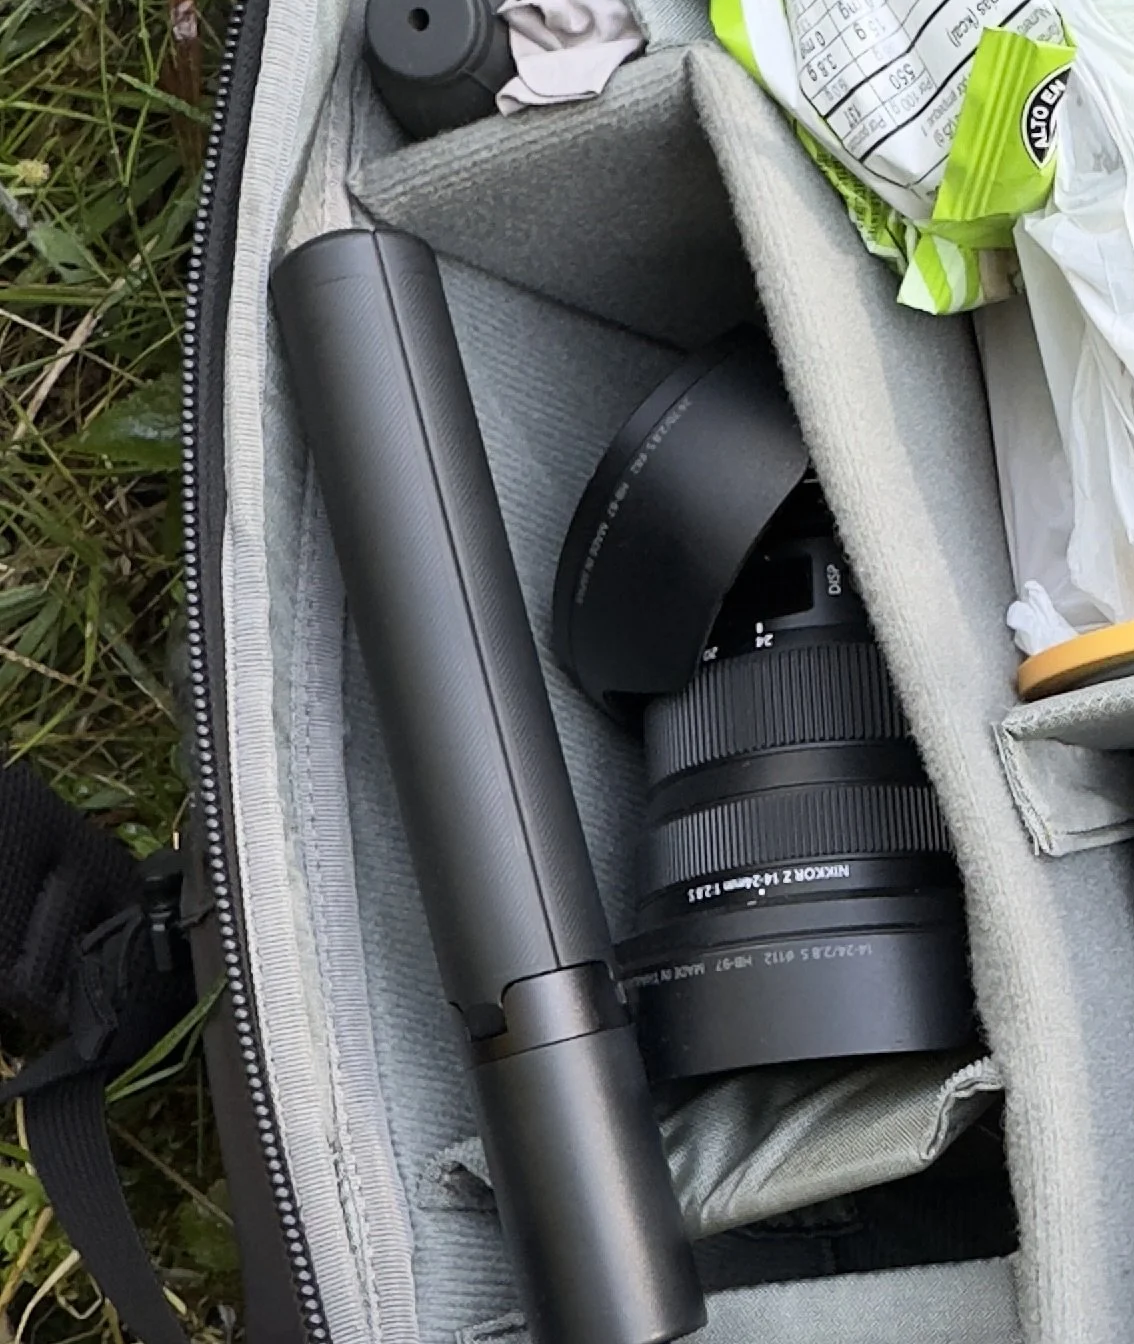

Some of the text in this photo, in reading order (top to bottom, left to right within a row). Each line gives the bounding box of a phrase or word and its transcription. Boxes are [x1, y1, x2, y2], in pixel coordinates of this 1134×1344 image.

[853, 20, 867, 41] g
[946, 7, 980, 48] (kcal)
[888, 63, 917, 91] 550
[1030, 78, 1067, 149] ALTO EN
[826, 563, 842, 596] DISP
[755, 632, 775, 649] 24
[782, 869, 792, 884] Z
[794, 863, 850, 883] NIKKOR
[800, 947, 810, 962] S
